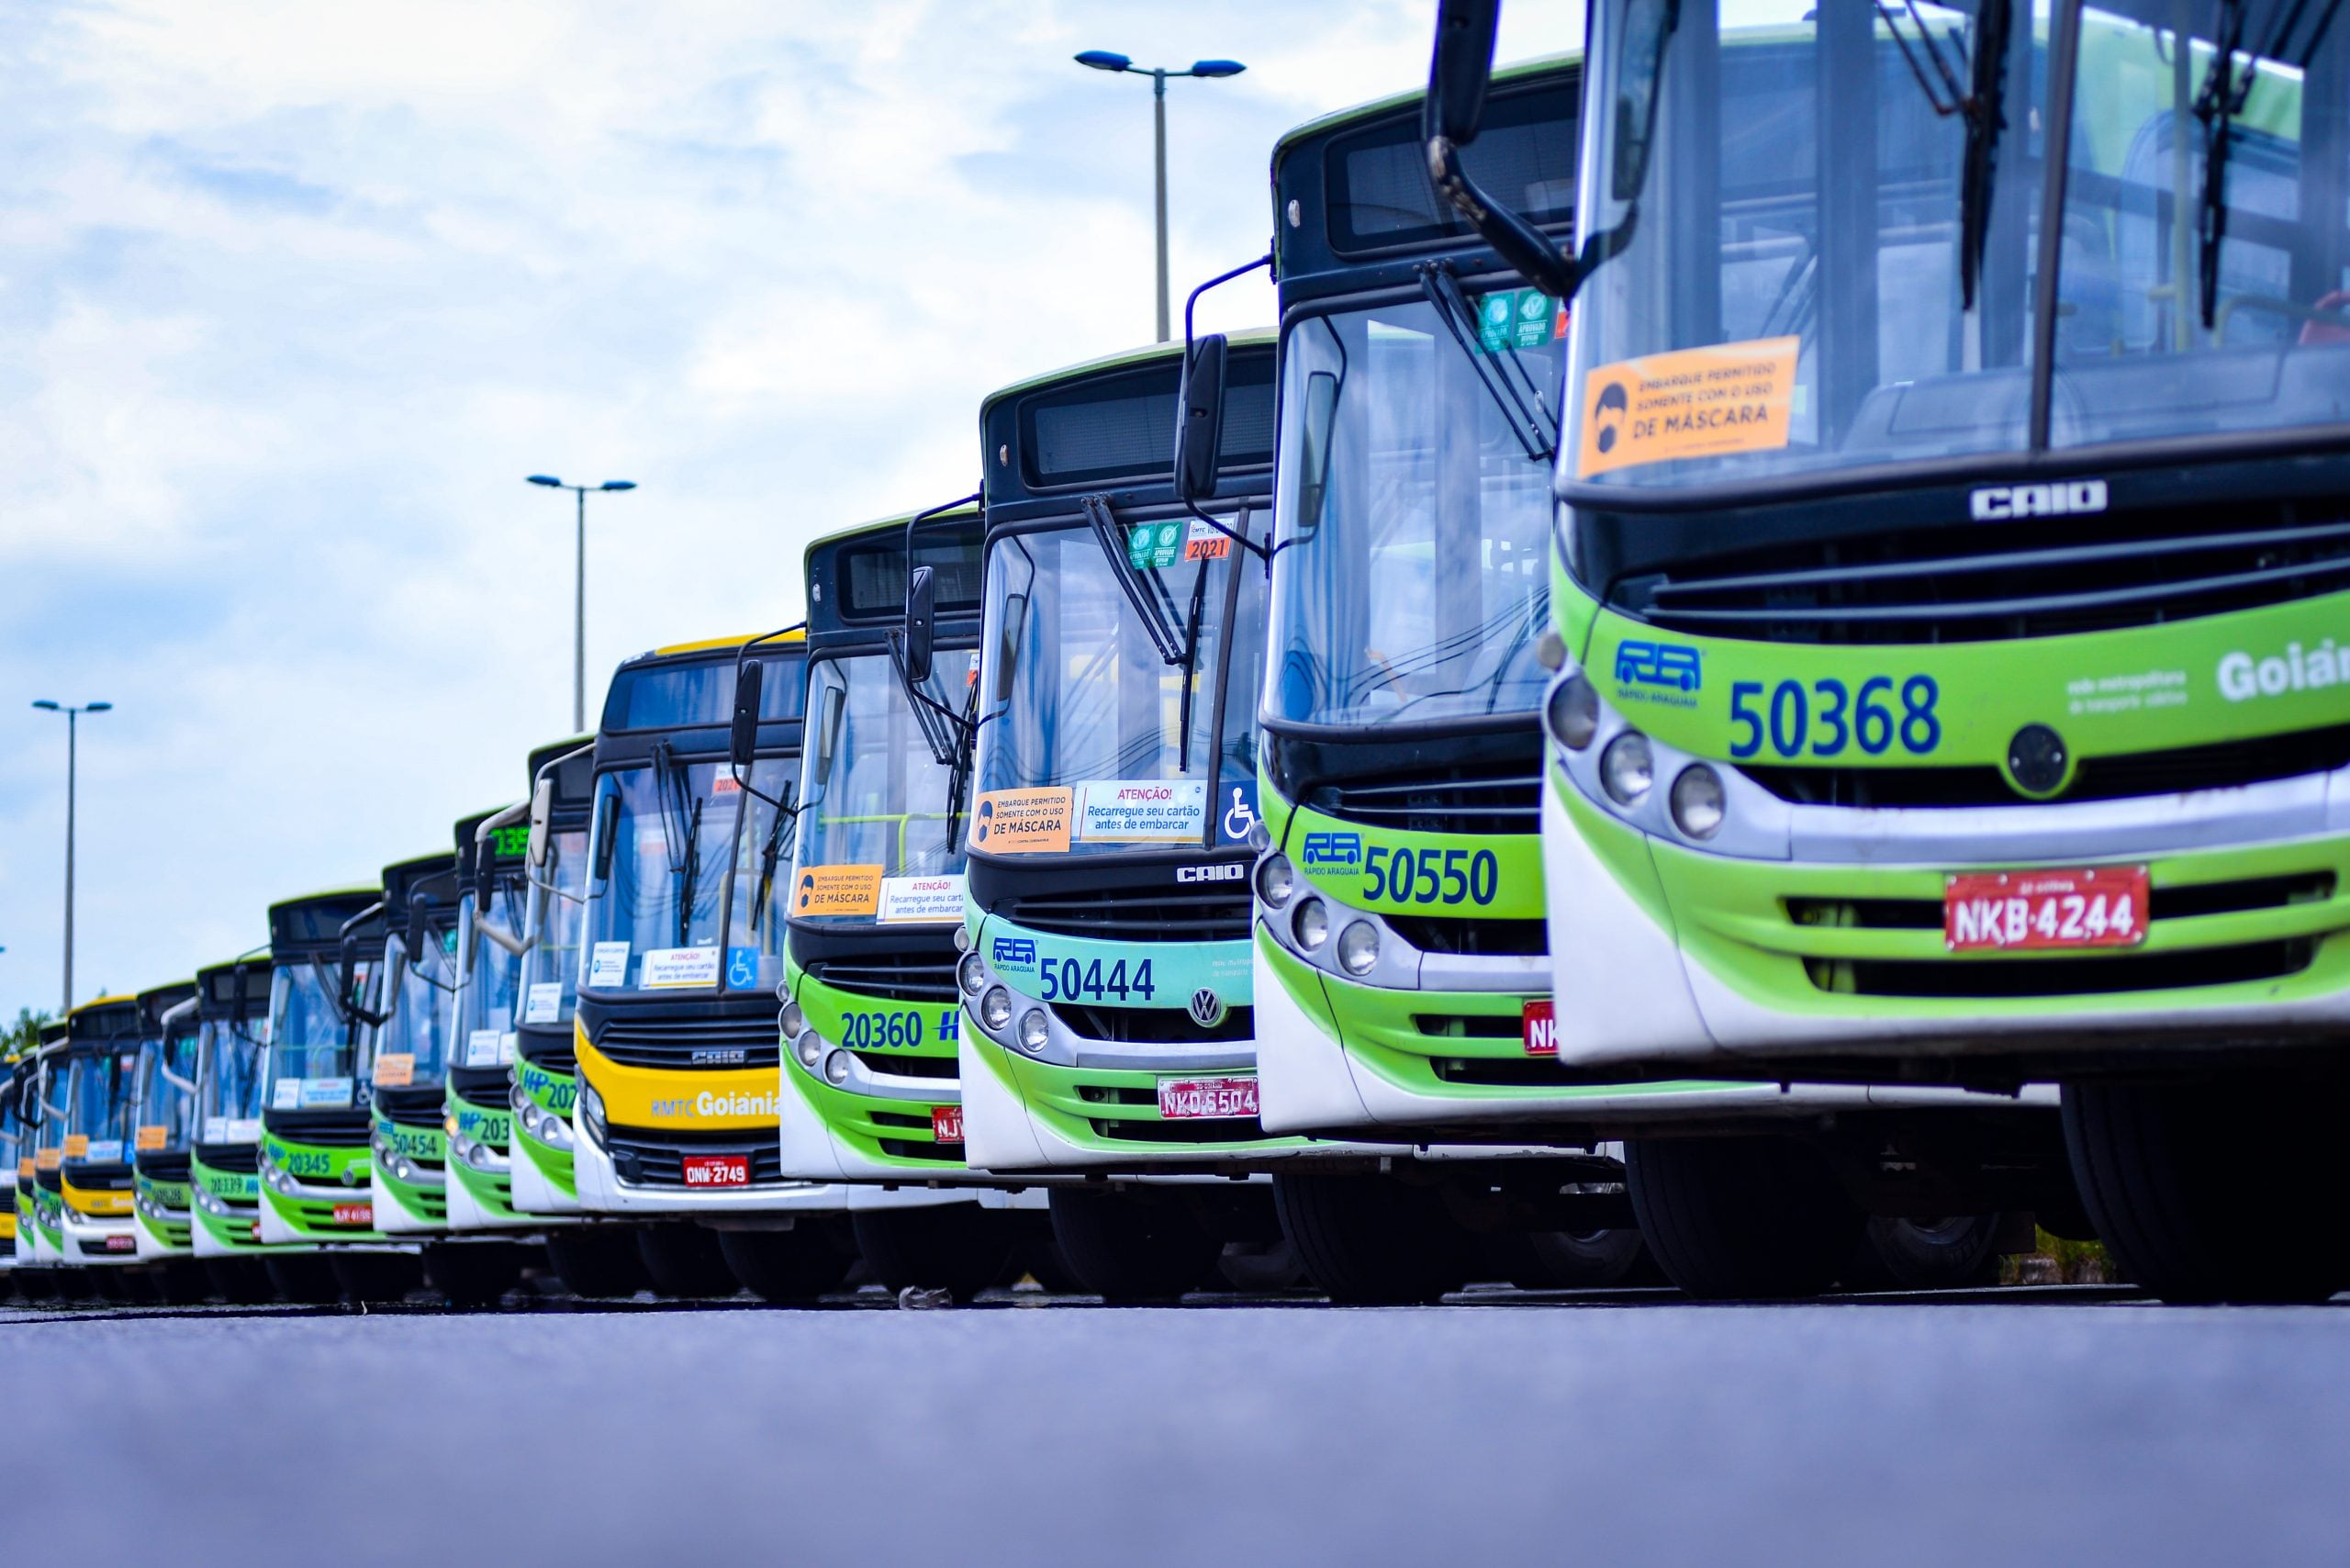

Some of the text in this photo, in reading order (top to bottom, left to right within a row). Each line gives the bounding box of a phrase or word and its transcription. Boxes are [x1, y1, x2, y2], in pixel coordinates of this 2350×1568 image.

[1639, 362, 1777, 393] EMBARQUE PERMITIDO
[1638, 382, 1774, 411] SOMENTE COM O USO
[1633, 403, 1769, 439] DE MÁSCARA
[1971, 479, 2108, 521] CAIO
[1190, 539, 1225, 558] 2021
[1729, 673, 1942, 758] 50368
[1117, 787, 1172, 801] ATENÇÃO!
[998, 797, 1066, 808] EMBARQUE PERMITIDO
[996, 810, 1024, 819] SOMENTE
[1025, 809, 1041, 817] COM
[1088, 806, 1144, 818] Recarregue
[1167, 805, 1200, 816] cartão
[994, 819, 1061, 834] DE MÁSCARA
[1095, 819, 1189, 830] antes de embarcar
[1177, 864, 1244, 882] CAIO
[1326, 867, 1360, 875] ARAGUAIA
[1363, 846, 1499, 906] 50550
[912, 880, 951, 890] ATENÇÃO!
[814, 891, 869, 903] DE MÁSCARA
[890, 895, 930, 904] Recarregue
[928, 904, 963, 913] embarcar
[1010, 965, 1035, 973] ARAGUAIA
[1040, 958, 1155, 1002] 50444
[842, 1011, 923, 1048] 20360
[692, 1050, 744, 1065] CAIO
[652, 1100, 695, 1116] RMTC
[392, 1134, 437, 1155] 50454
[287, 1152, 330, 1174] 20345
